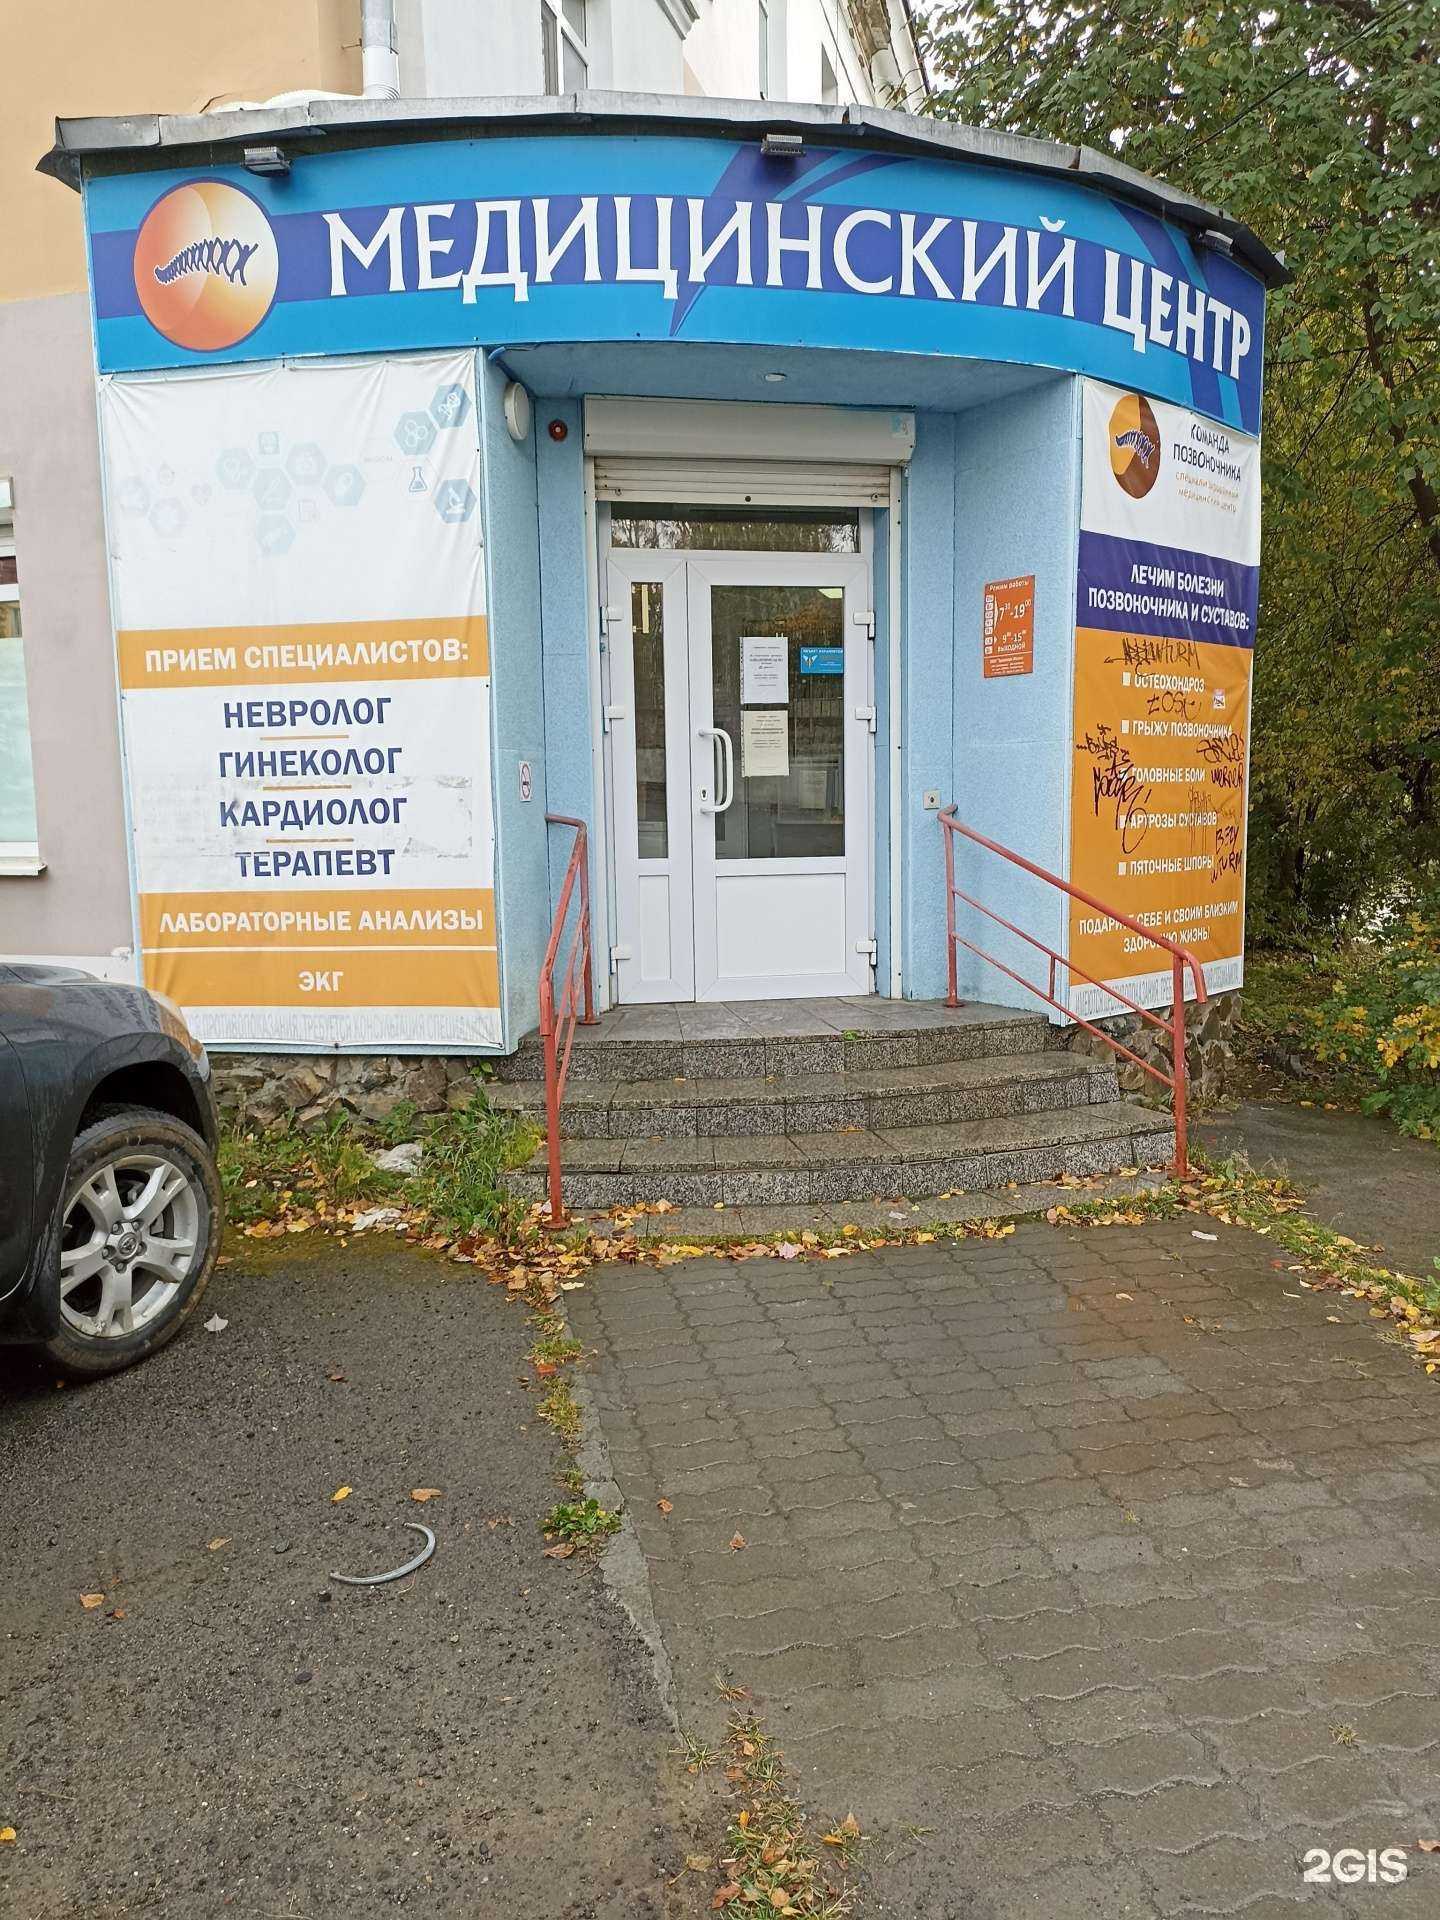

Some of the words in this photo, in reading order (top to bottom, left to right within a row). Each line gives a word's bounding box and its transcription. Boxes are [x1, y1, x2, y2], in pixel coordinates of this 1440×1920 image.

[322, 196, 1076, 316] МЕДИЦИНСКИЙ
[1103, 249, 1251, 379] ЦЕНТР
[1190, 423, 1230, 454] КОМАНДА
[1173, 443, 1241, 482] ПОЗВОНОЧНИКА
[1131, 564, 1175, 590] ЛЕЧИМ
[1177, 571, 1224, 597] БОЛЕЗНИ
[1089, 587, 1189, 620] ПОЗВОНОЧНИКА
[1191, 603, 1199, 618] И
[1201, 605, 1250, 630] СУСТАВОВ:
[145, 645, 237, 672] ПРИЕМ
[244, 638, 469, 671] СПЕЦИАЛИСТОВ:
[1134, 672, 1205, 693] ОСТЕОХОНДРОЗ
[223, 698, 392, 728] НЕВРОЛОГ
[1132, 720, 1168, 736] ГРЫЖУ
[1171, 721, 1232, 738] ПОЗВОНОЧНИКА
[219, 747, 402, 777] ГИНЕКОЛОГ
[1132, 767, 1183, 783] ГОЛОВНЫЕ
[1185, 767, 1206, 783] БОЛИ
[220, 798, 407, 831] КАРДИОЛОГ
[1130, 813, 1176, 828] АРТРОЗЫ
[1179, 811, 1217, 827] СУСТАВОВ
[235, 849, 395, 877] ТЕРАПЕВТ
[1130, 858, 1182, 875] ПЯТОЧНЫЕ
[1184, 855, 1214, 871] ШПОРЫ
[160, 910, 351, 932] ЛАБОРАТОРНЫЕ
[358, 910, 483, 931] АНАЛИЗЫ
[1136, 911, 1162, 928] СЕБЕ
[1164, 912, 1171, 925] И
[1173, 906, 1203, 923] СВОИМ
[1204, 900, 1239, 919] БЛИЗКИМ
[1180, 926, 1210, 943] ЖИЗНЬ!
[298, 971, 344, 993] ЭКГ
